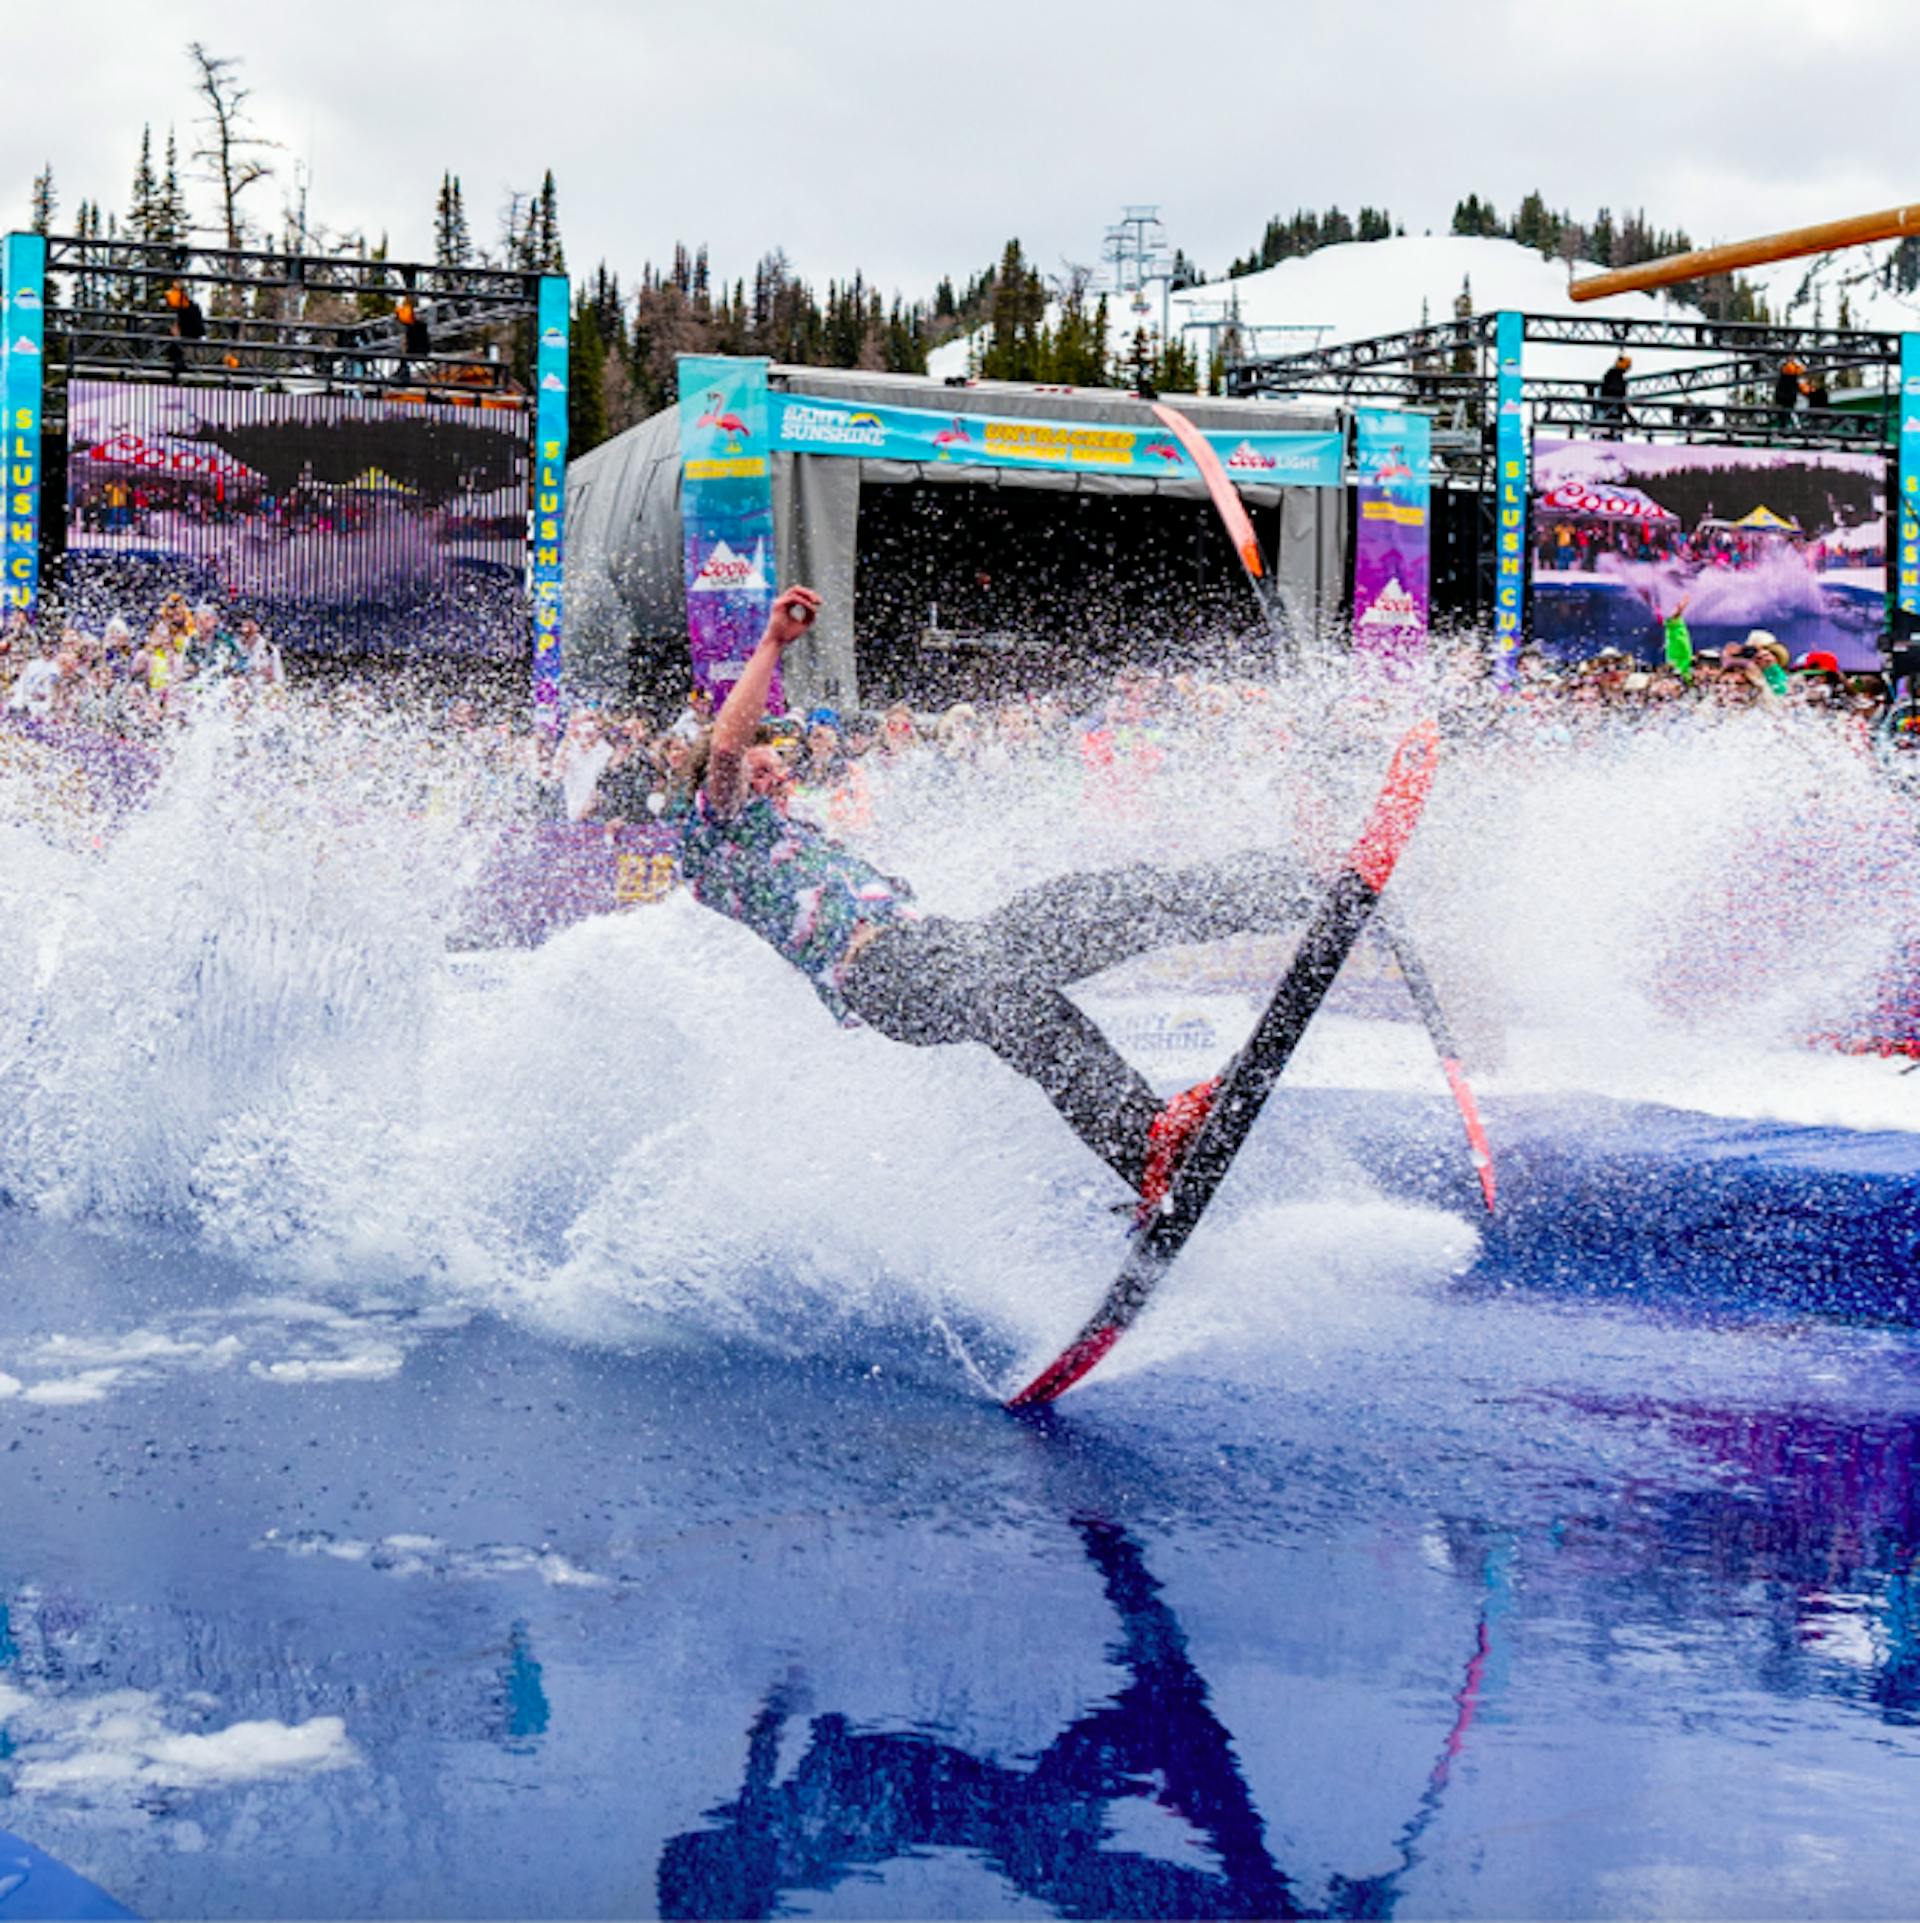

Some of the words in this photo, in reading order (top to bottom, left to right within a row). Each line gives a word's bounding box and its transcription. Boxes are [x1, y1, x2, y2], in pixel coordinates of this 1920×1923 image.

[11, 408, 33, 543] SLUSH
[984, 422, 1136, 449] UNTRACKED
[538, 440, 560, 567] SLUSH
[1502, 460, 1521, 575] SLUSH
[11, 557, 32, 607] CU
